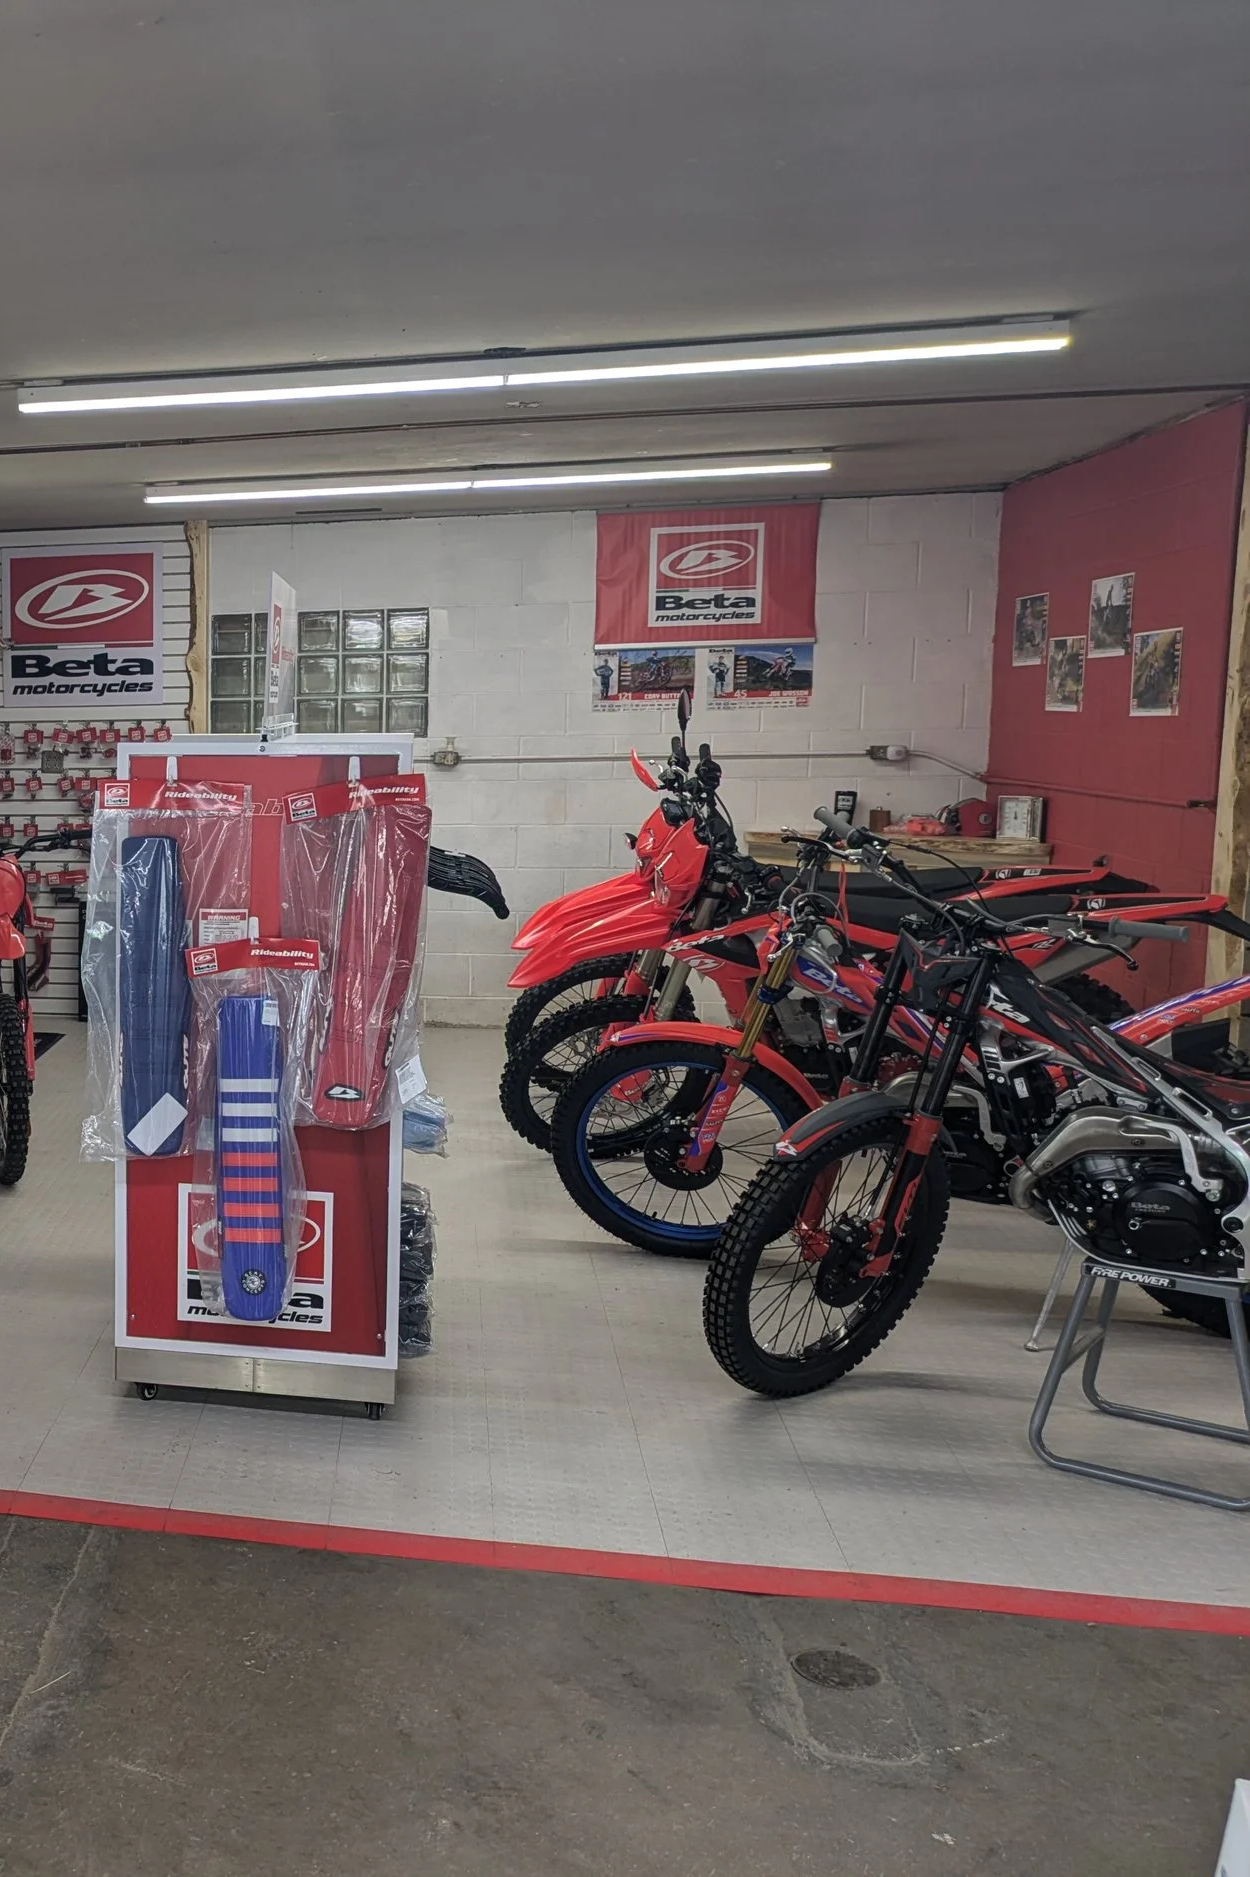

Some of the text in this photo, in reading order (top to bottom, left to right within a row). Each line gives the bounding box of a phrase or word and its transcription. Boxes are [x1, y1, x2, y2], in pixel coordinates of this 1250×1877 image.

[655, 593, 756, 611] Beta
[655, 610, 755, 622] motorcycles
[11, 652, 154, 679] Beta
[12, 680, 153, 697] motorcycles
[733, 690, 747, 698] 45
[164, 790, 238, 801] Rideability
[292, 786, 419, 818] Beta Rideability
[665, 934, 725, 951] Beta
[194, 948, 314, 971] Beta Rideability
[1130, 1201, 1171, 1211] Beta
[244, 1270, 263, 1278] SEAT
[1091, 1266, 1171, 1287] FIRE POWER
